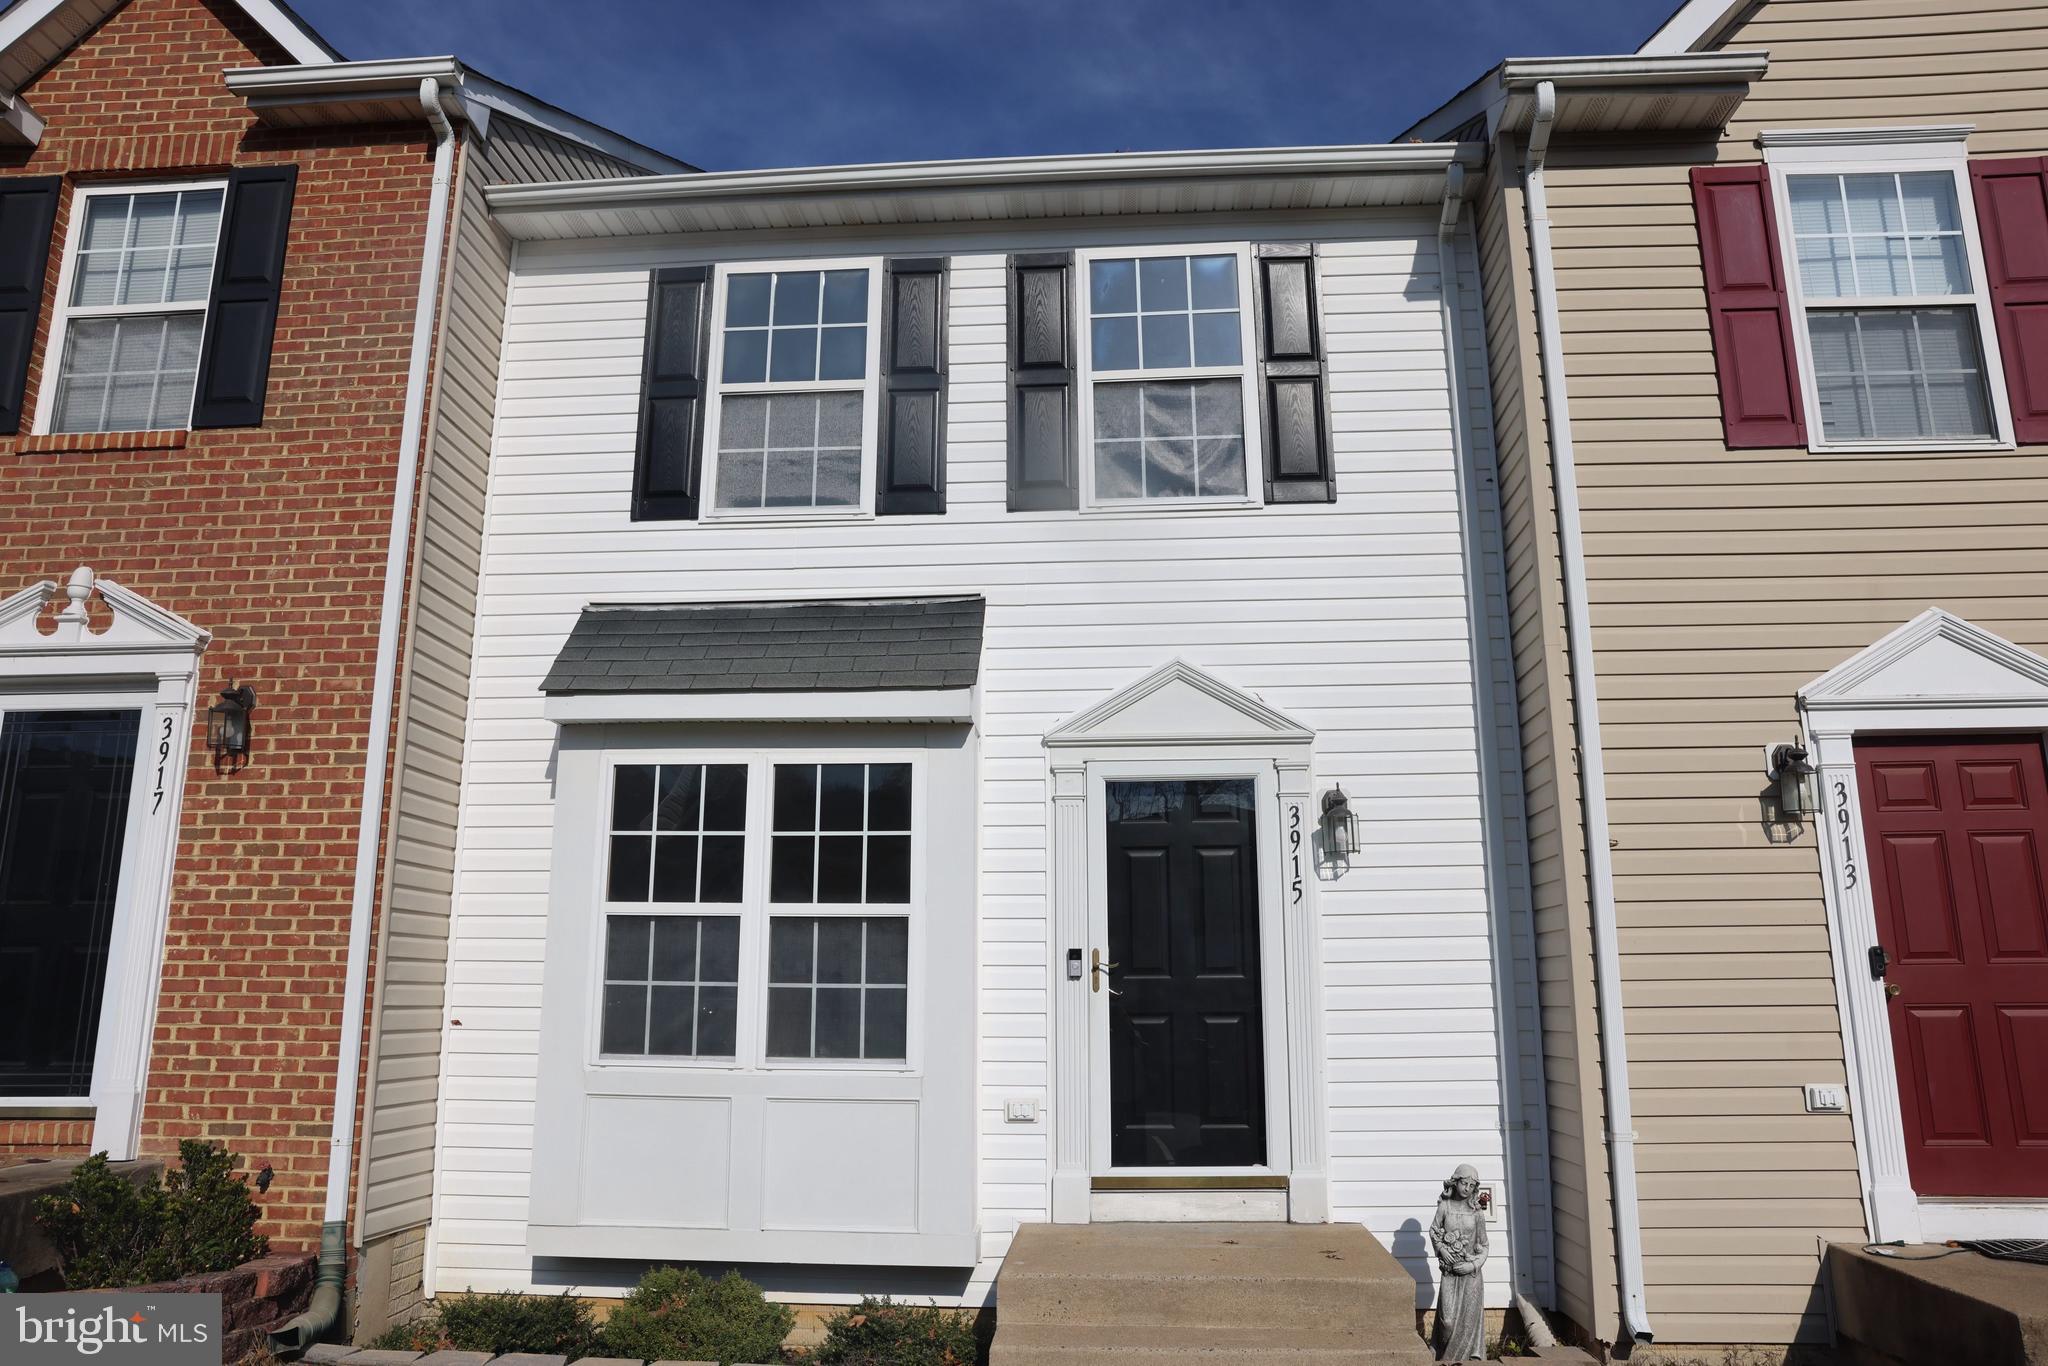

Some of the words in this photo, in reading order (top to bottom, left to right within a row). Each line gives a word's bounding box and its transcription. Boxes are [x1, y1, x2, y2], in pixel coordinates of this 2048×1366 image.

[152, 716, 173, 816] 3917
[1289, 805, 1303, 905] 3915
[1834, 781, 1857, 890] 3913
